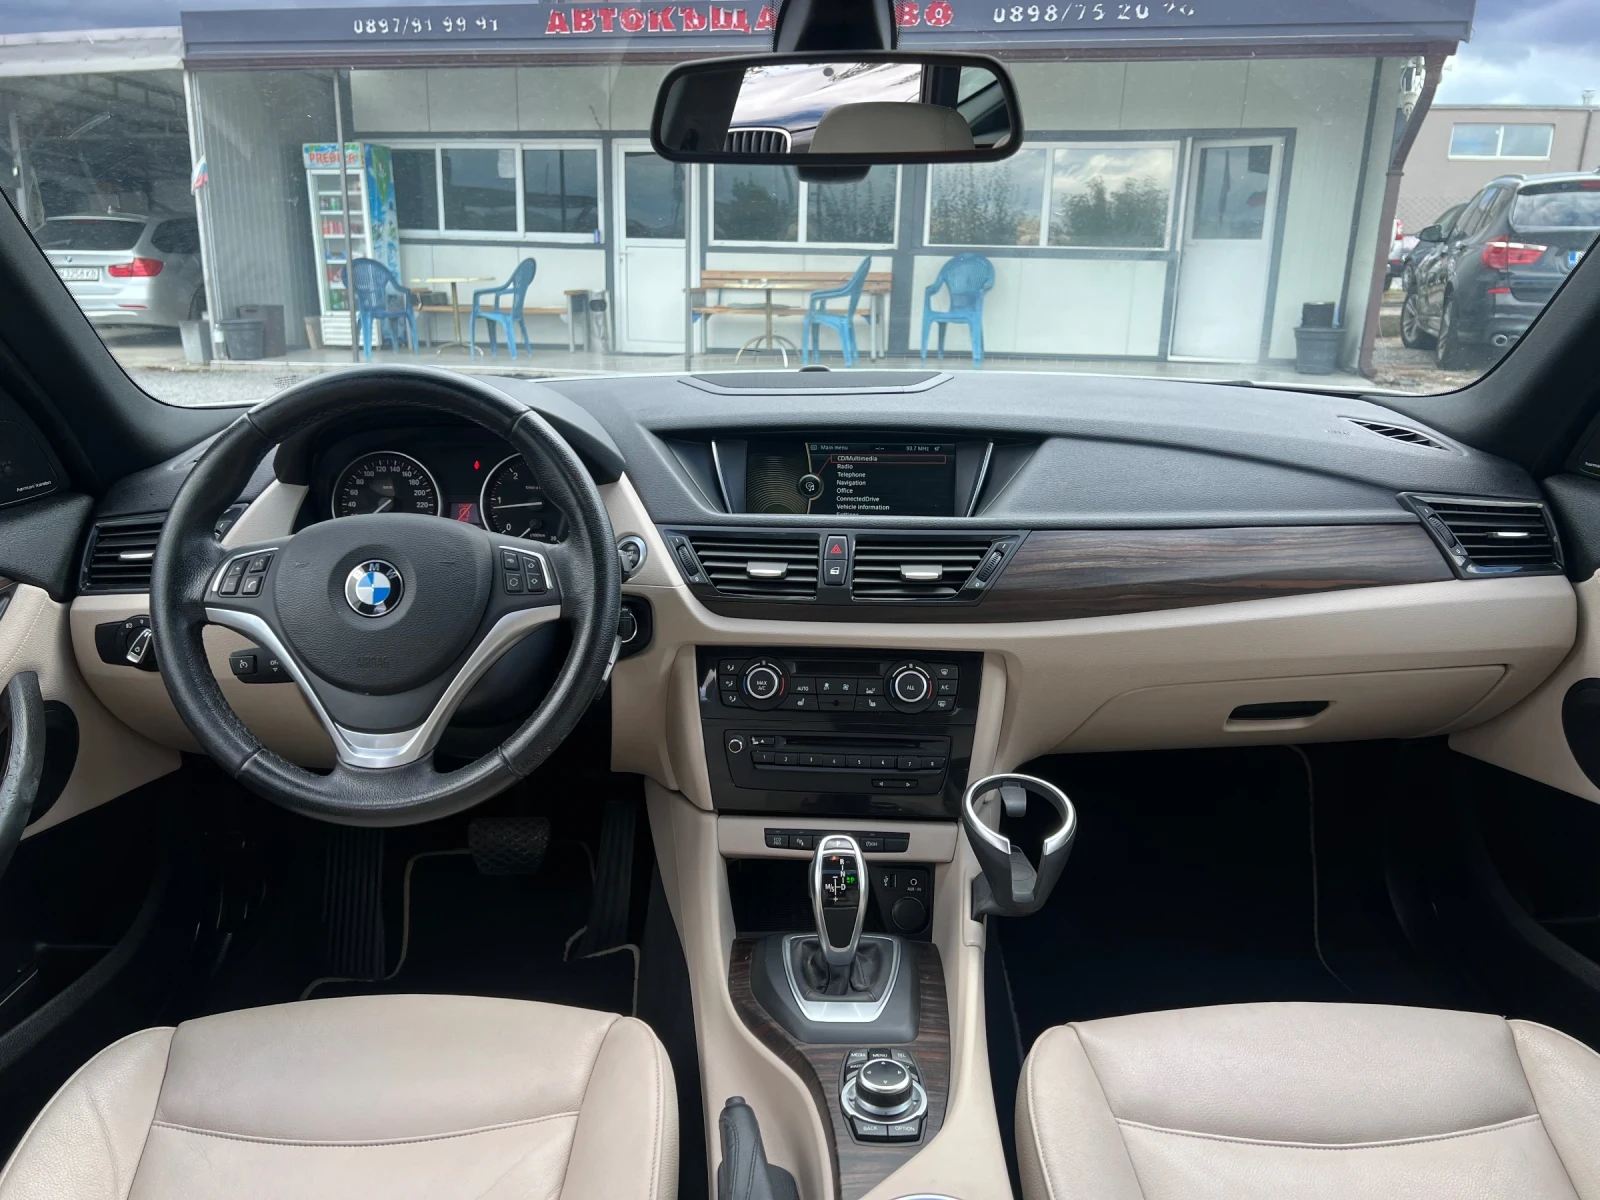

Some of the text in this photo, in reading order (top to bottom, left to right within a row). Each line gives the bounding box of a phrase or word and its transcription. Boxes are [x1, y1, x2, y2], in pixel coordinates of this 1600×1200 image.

[993, 2, 1106, 23] 0898/75
[353, 16, 433, 35] 0897/91
[513, 472, 518, 480] 2
[497, 496, 502, 504] 1
[506, 523, 512, 531] 0
[352, 562, 398, 580] BMW
